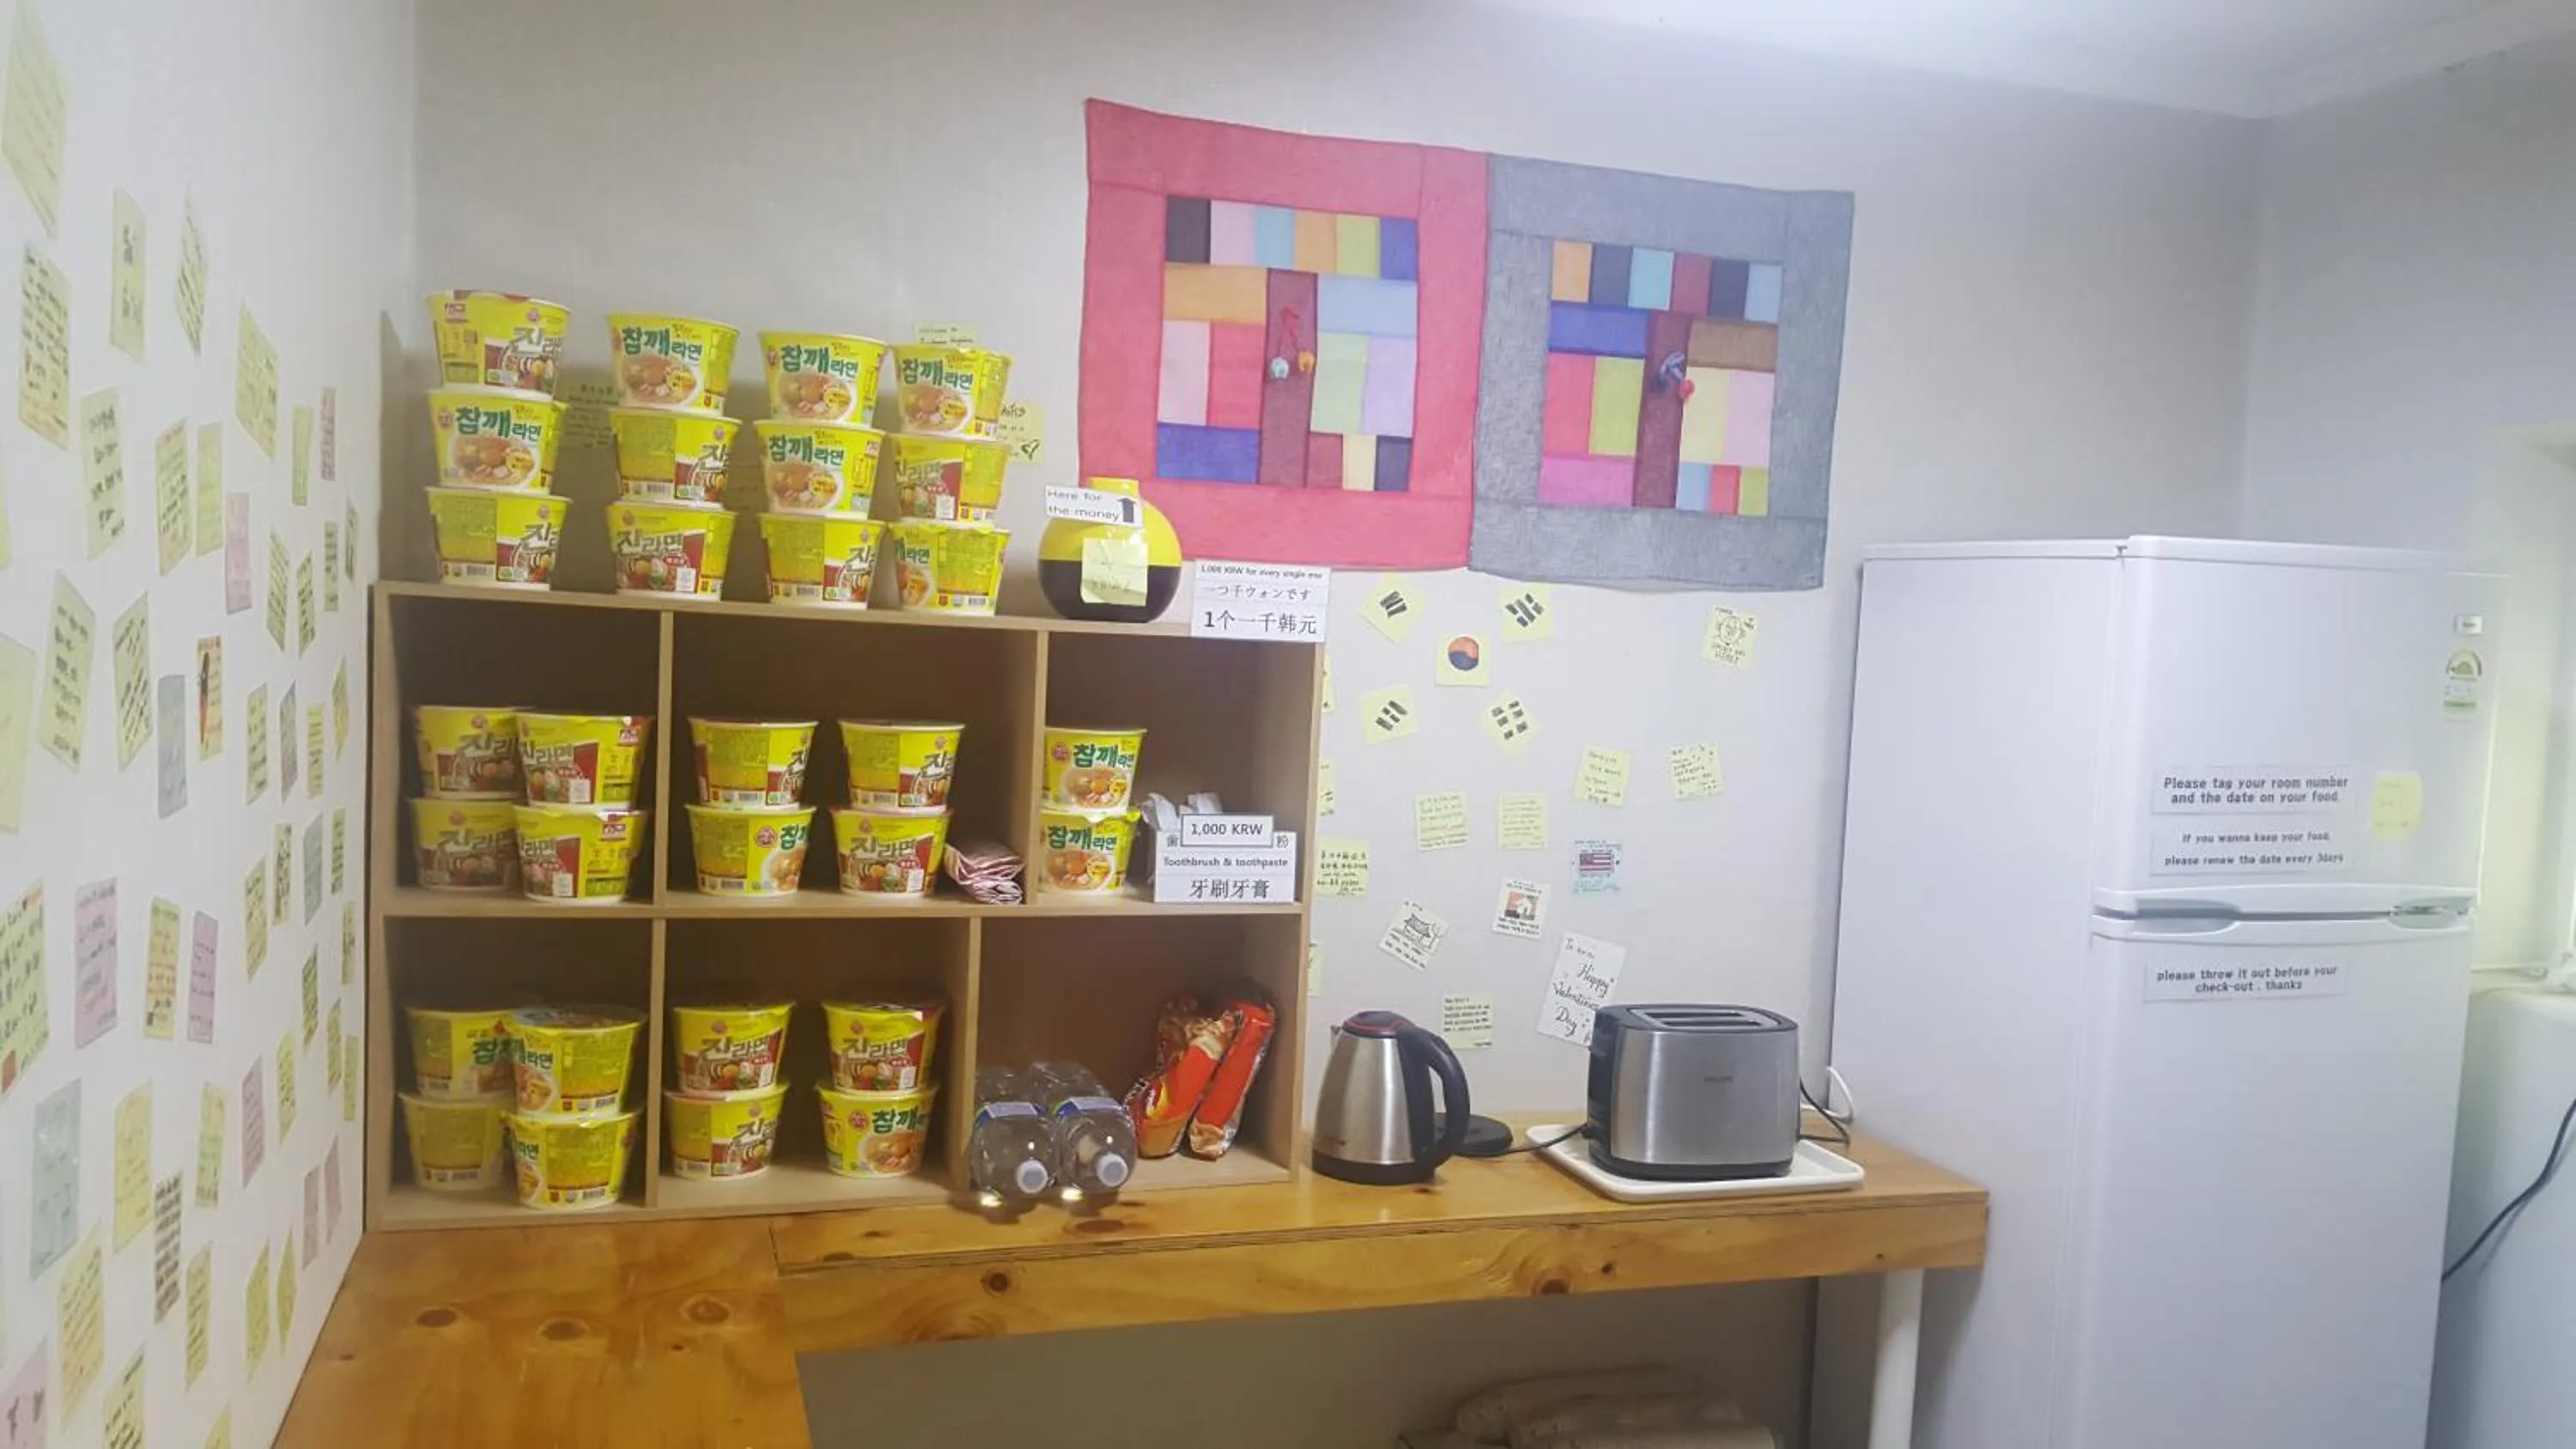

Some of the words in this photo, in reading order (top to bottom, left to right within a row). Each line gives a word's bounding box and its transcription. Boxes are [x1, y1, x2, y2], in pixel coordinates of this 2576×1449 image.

[1084, 492, 1101, 500] for
[1048, 506, 1069, 515] the
[1075, 509, 1121, 522] money
[2163, 778, 2207, 789] Please
[2213, 778, 2233, 790] tag
[2238, 779, 2266, 790] your
[2271, 779, 2302, 788] room
[2306, 776, 2349, 788] number
[2171, 792, 2195, 803] and
[2201, 791, 2221, 803] the
[2227, 791, 2254, 803] date
[2260, 793, 2275, 803] on
[2280, 793, 2306, 803] your
[1191, 823, 1227, 836] 1,000
[1231, 823, 1263, 835] KRW
[2196, 834, 2215, 844] you
[2281, 834, 2303, 843] your
[1163, 858, 1220, 866] Toothbrush
[1236, 858, 1289, 870] toothpaste
[2165, 856, 2199, 866] please
[2239, 855, 2256, 864] the
[2259, 855, 2281, 864] date
[1188, 878, 1270, 899] 牙刷牙膏
[2157, 969, 2196, 981] please
[2201, 969, 2233, 980] throw
[2238, 968, 2247, 979] it
[2251, 968, 2270, 979] out
[2275, 967, 2309, 978] before
[2266, 980, 2302, 991] thanks
